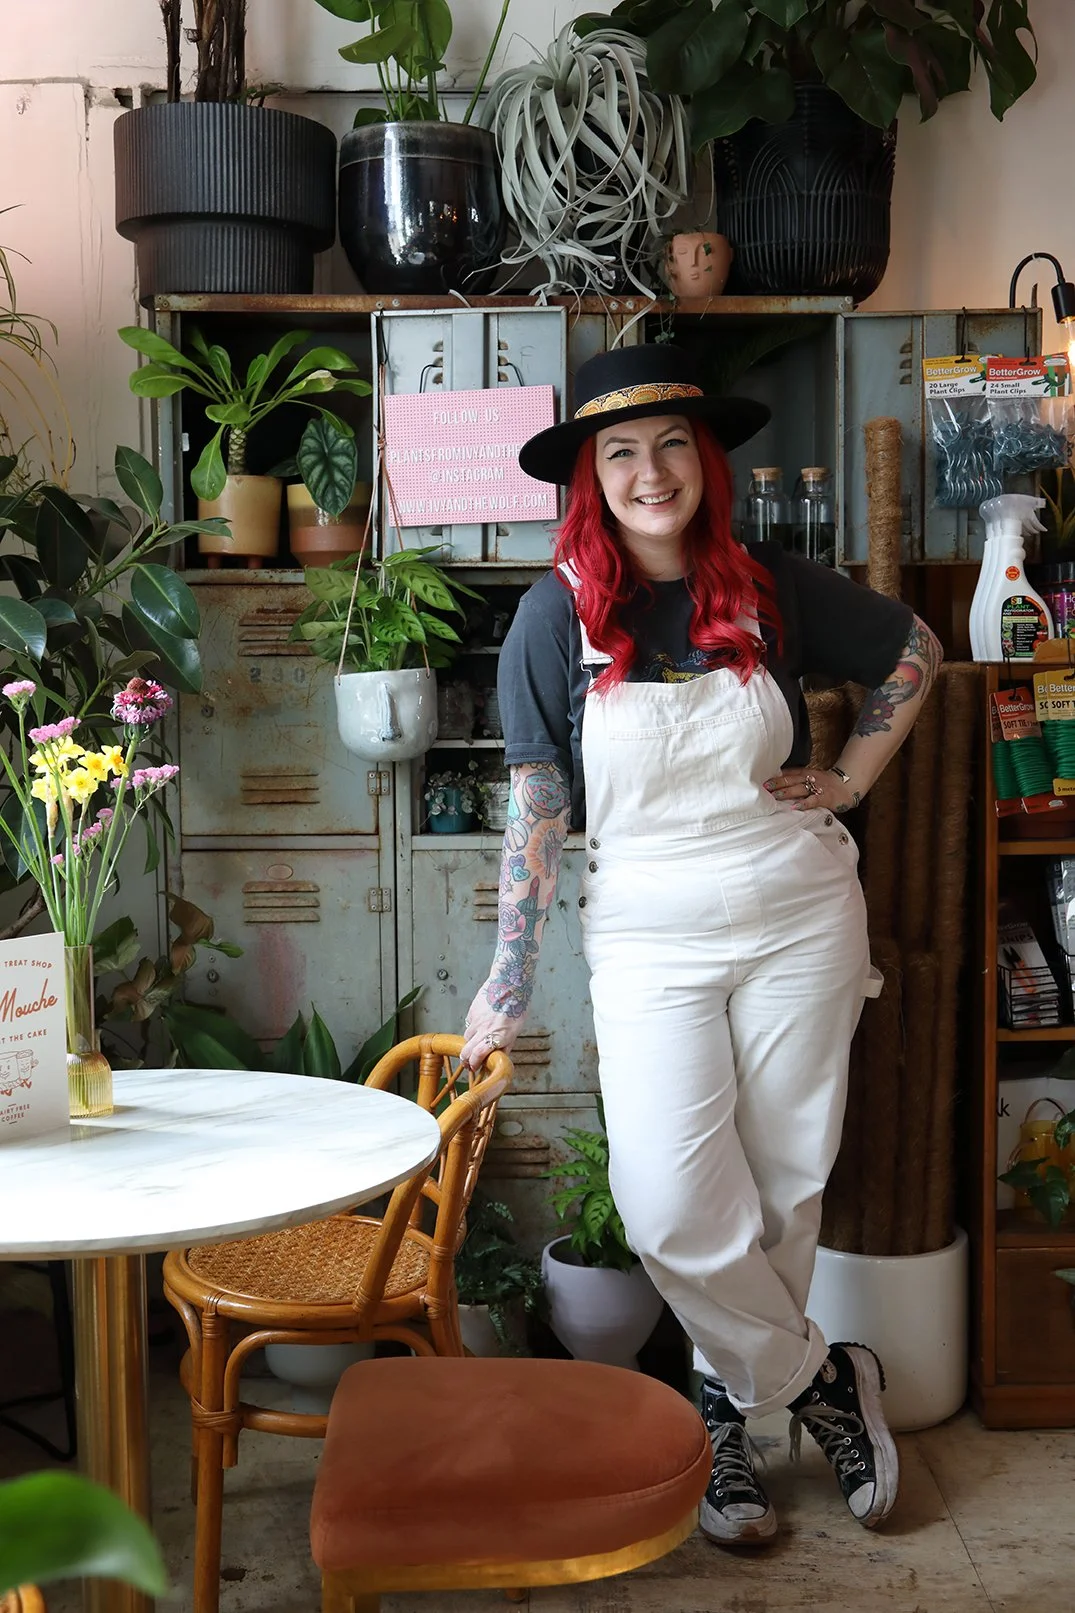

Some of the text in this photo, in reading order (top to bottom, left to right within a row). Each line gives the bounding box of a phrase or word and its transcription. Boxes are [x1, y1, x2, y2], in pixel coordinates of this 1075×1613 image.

[926, 366, 977, 376] BetterGrow
[989, 368, 1041, 377] BetterGrow
[939, 382, 958, 390] Large
[434, 408, 500, 425] FOLLOW US
[431, 467, 505, 484] @INSTAGRAM
[1051, 700, 1070, 709] SOFT
[1003, 720, 1018, 729] SOFT
[4, 960, 53, 969] TREAT SHOP
[0, 978, 58, 1022] Mouche
[9, 1033, 24, 1042] THE
[27, 1028, 48, 1039] CAKE
